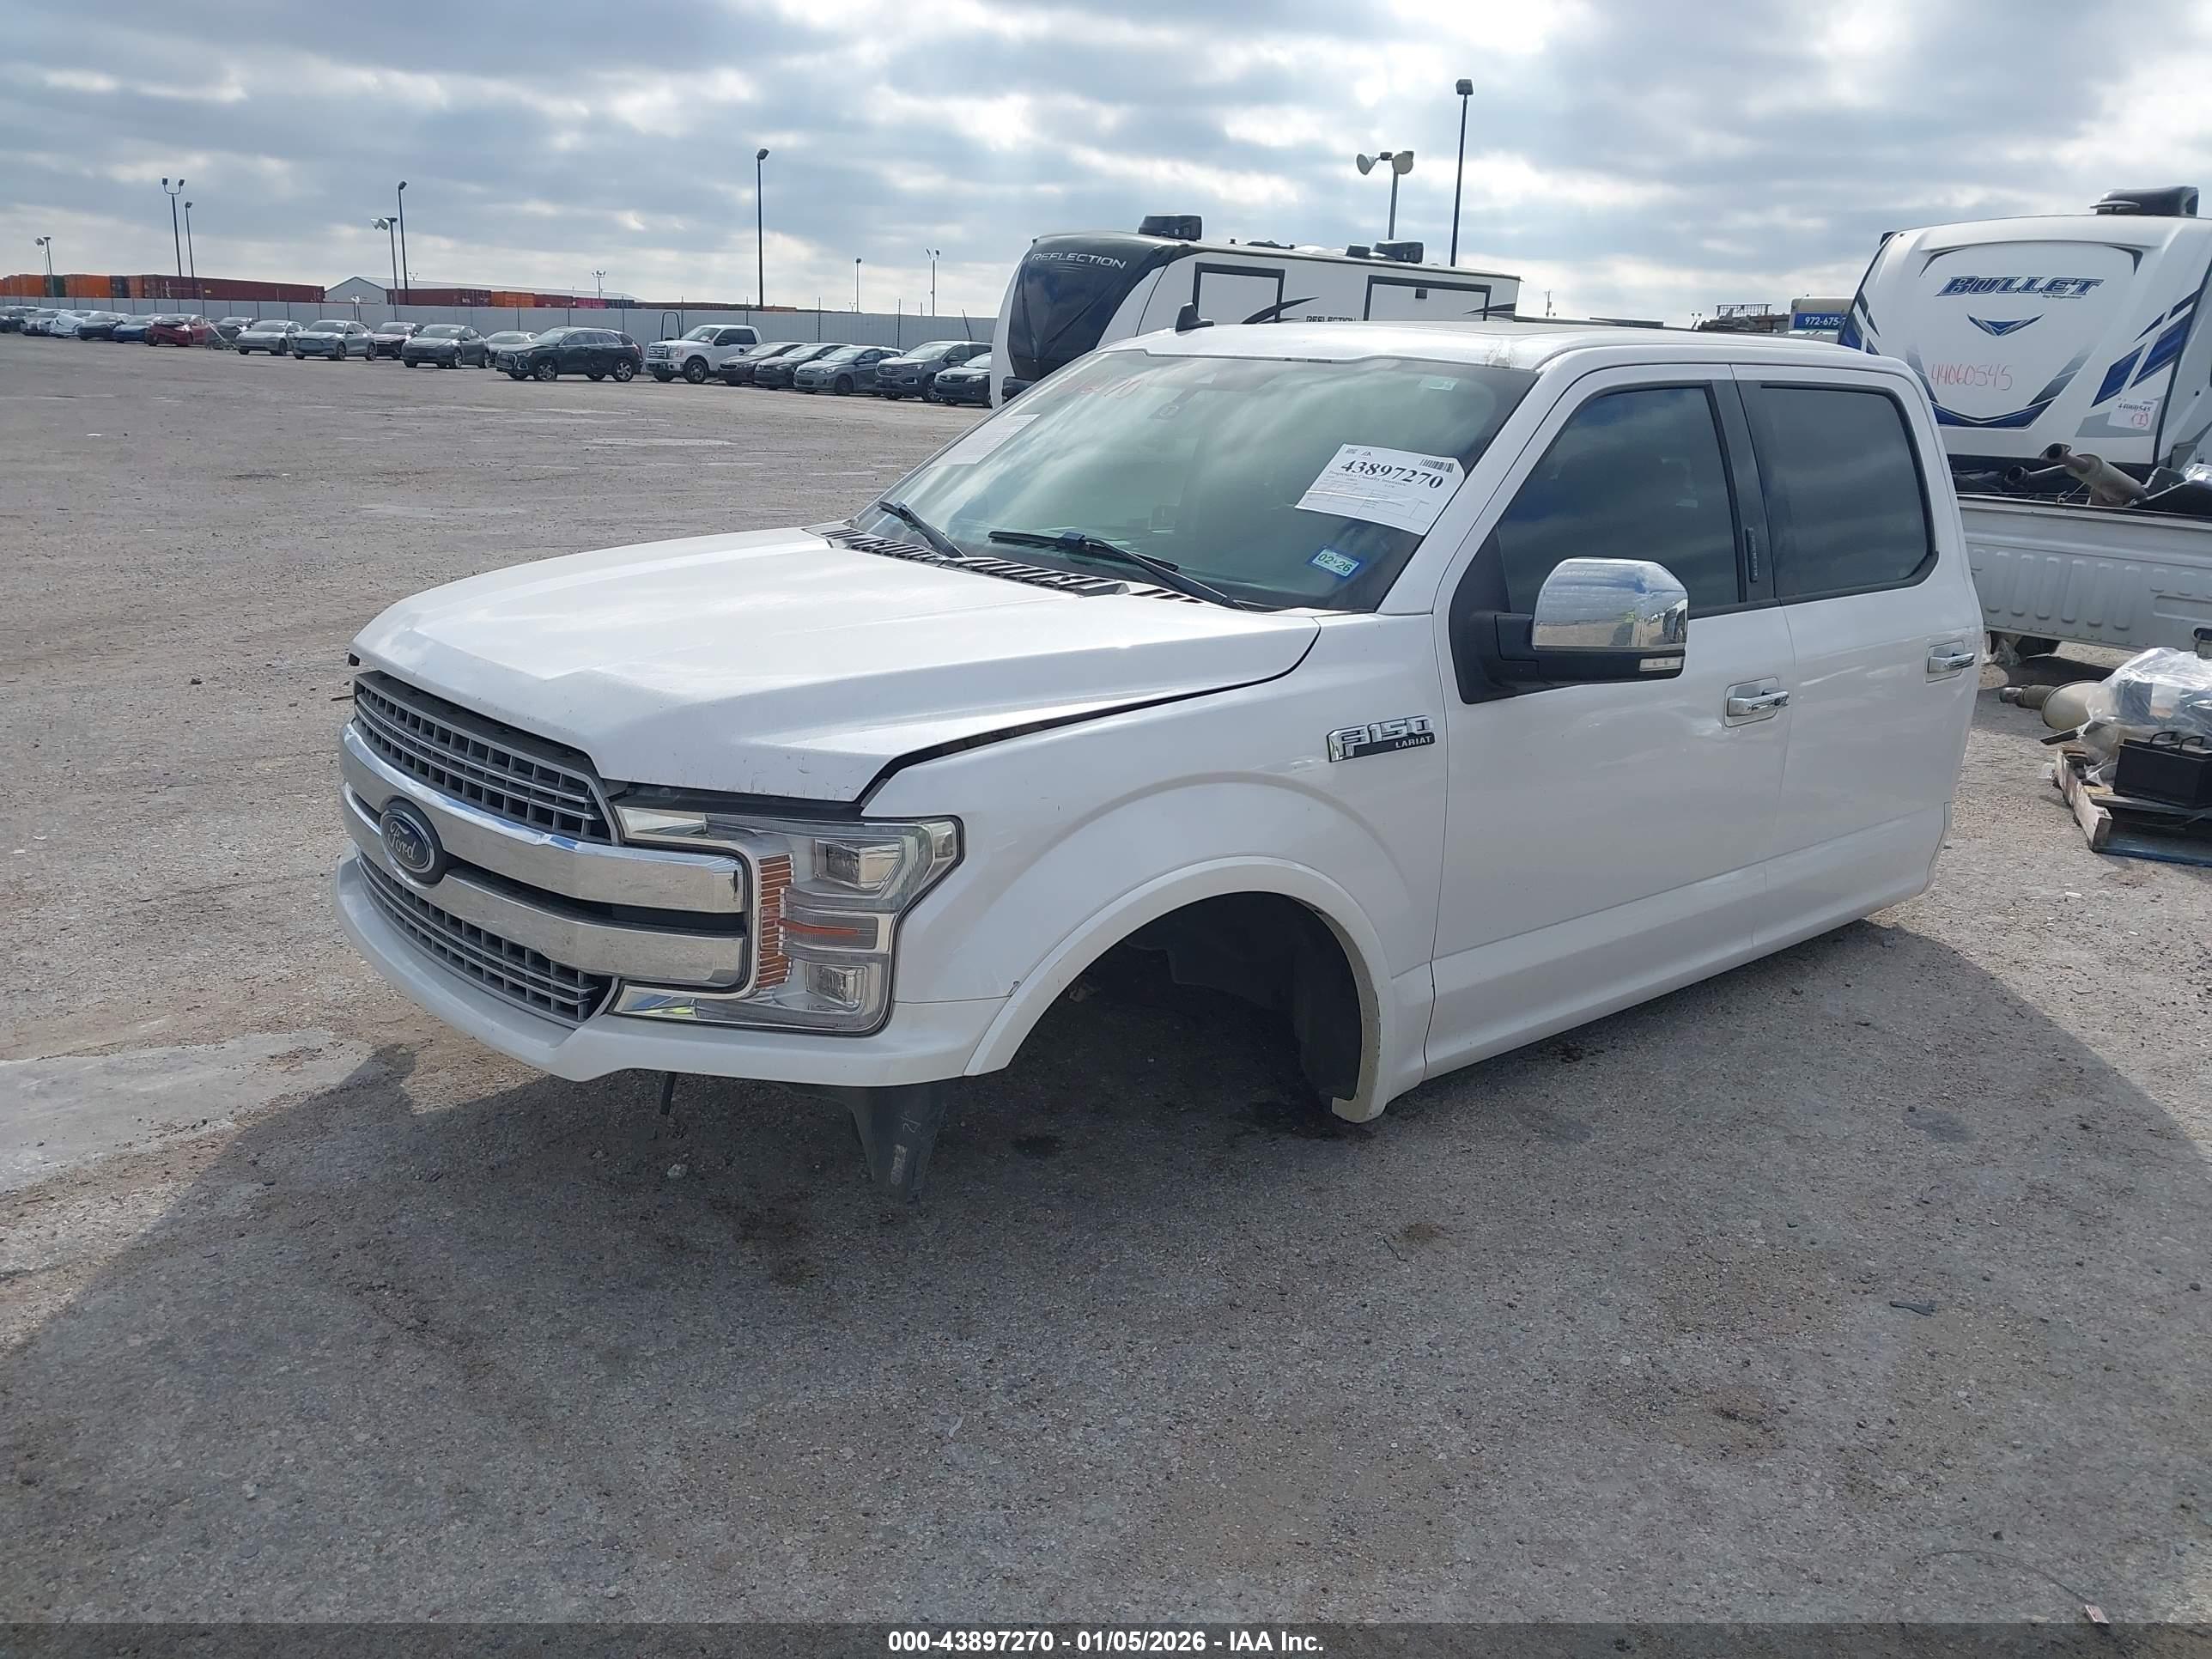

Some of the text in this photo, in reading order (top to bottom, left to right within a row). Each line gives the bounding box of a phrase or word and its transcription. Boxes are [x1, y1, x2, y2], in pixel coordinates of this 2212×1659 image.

[1030, 252, 1127, 269] REFLECTION
[1935, 275, 2104, 296] BULLET
[1931, 363, 2013, 391] 44060545
[1340, 459, 1444, 489] 43897270
[1395, 735, 1431, 749] LARIAT
[388, 821, 416, 860] Ford
